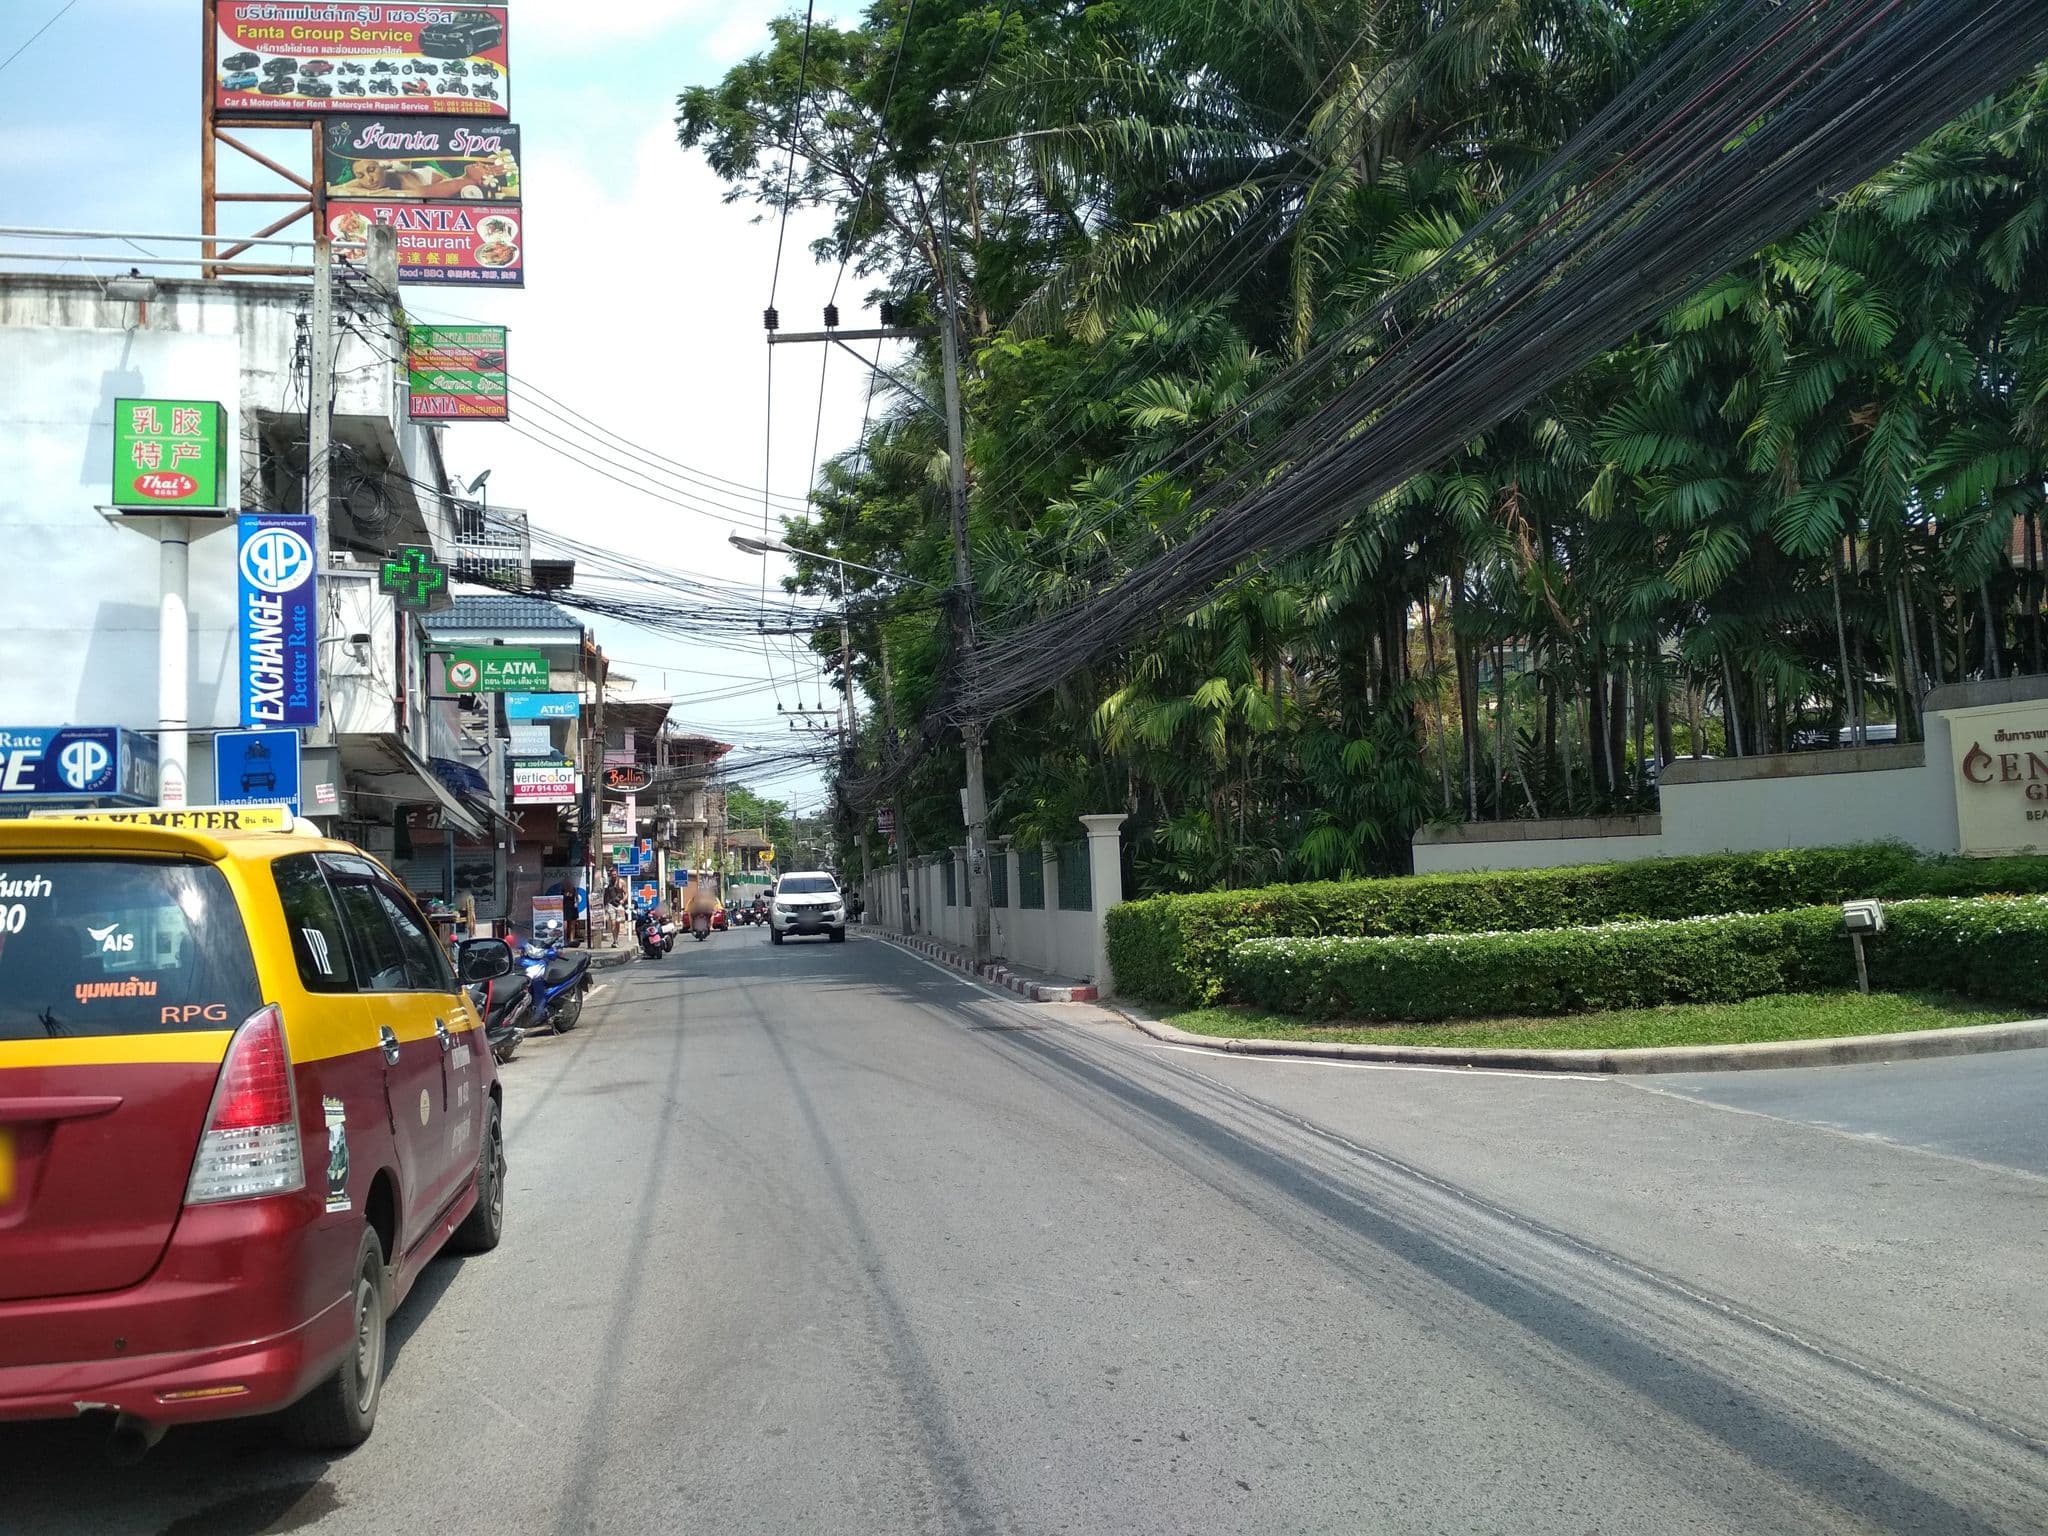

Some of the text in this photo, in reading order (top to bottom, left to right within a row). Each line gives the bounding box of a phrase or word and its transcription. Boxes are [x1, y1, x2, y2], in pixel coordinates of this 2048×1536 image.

[237, 24, 413, 42] Fanta Group Service
[224, 97, 430, 111] Car & Motorbike for Rent Motorcycle Repair Service
[353, 122, 501, 158] Fanta Spa
[374, 207, 475, 231] FANTA
[423, 269, 445, 279] BBQ
[412, 397, 458, 414] FANTA
[132, 407, 201, 435] 乳胶
[132, 441, 201, 469] 特产
[142, 476, 192, 489] Thai's
[288, 604, 307, 647] Rate
[249, 593, 284, 721] EXCHANGE
[502, 662, 537, 675] ATM
[289, 650, 308, 708] Better
[540, 705, 565, 714] ATM
[0, 732, 42, 747] Rate
[0, 750, 42, 791] E
[607, 768, 645, 787] Bellini
[537, 784, 551, 792] 914
[553, 784, 567, 792] 000
[2025, 783, 2048, 800] G
[102, 934, 134, 952] AIS
[301, 927, 333, 975] VIP
[160, 1004, 227, 1024] RPG
